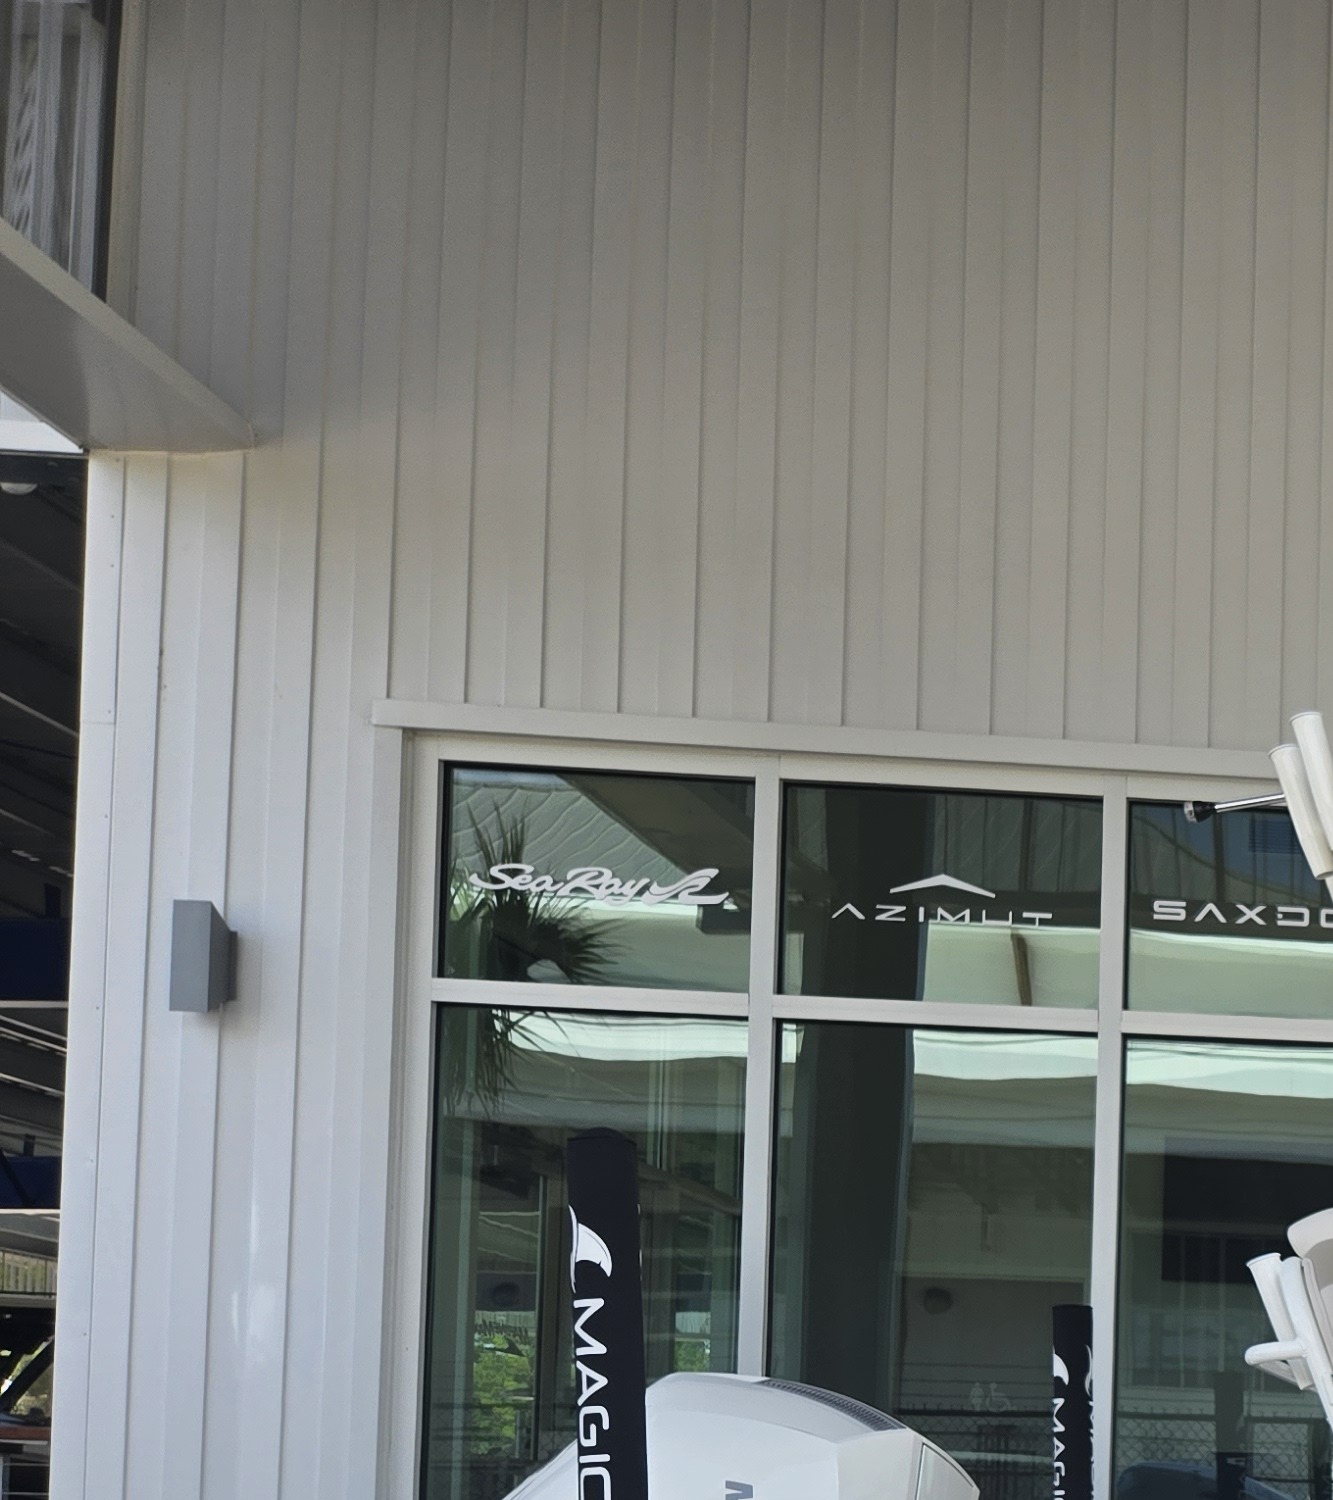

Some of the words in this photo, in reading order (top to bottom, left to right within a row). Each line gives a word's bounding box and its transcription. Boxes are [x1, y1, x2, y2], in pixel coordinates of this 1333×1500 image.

[469, 863, 564, 892] Sea
[559, 867, 649, 906] Ray
[831, 902, 1053, 928] AZIMUT
